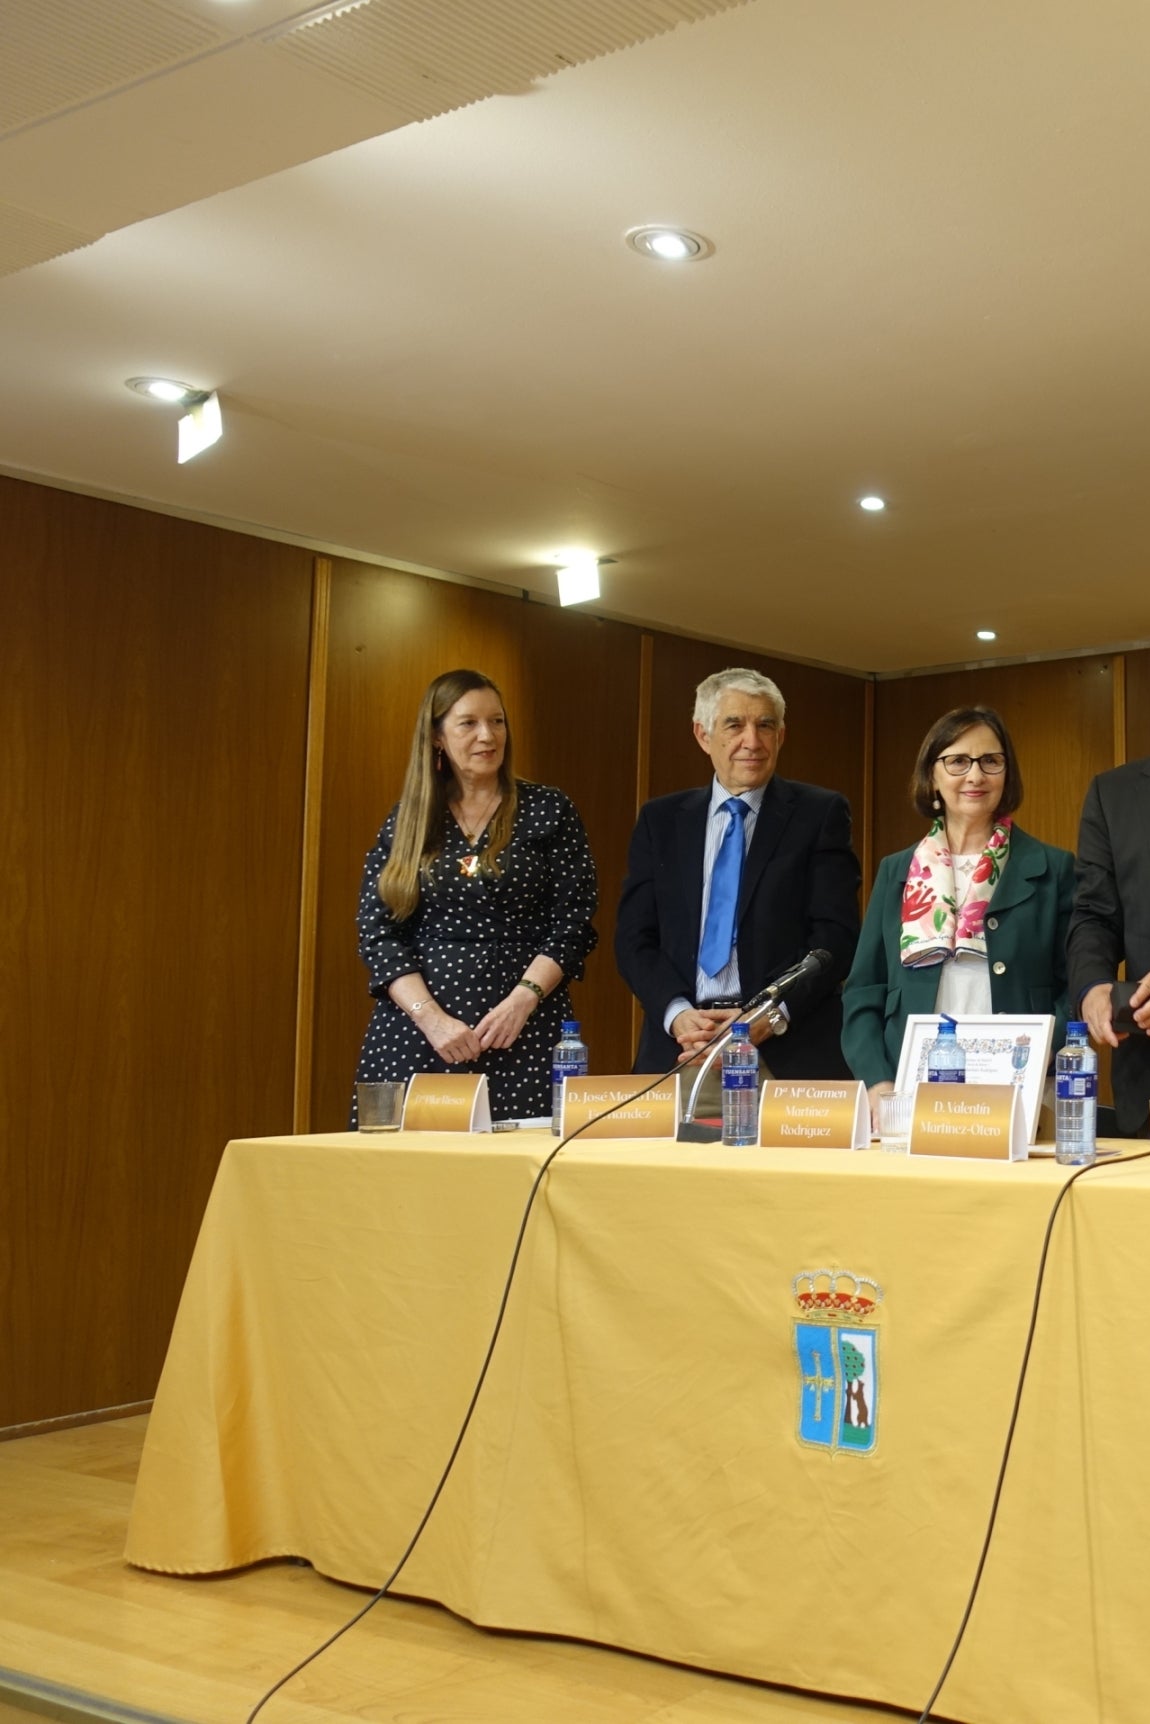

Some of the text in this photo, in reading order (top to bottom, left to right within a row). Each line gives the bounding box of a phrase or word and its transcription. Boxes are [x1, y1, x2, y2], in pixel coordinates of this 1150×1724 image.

[568, 1092, 580, 1103] D.
[583, 1091, 608, 1104] José
[646, 1090, 673, 1101] Díaz
[806, 1087, 847, 1099] Carmen
[934, 1100, 991, 1115] D. Valentín
